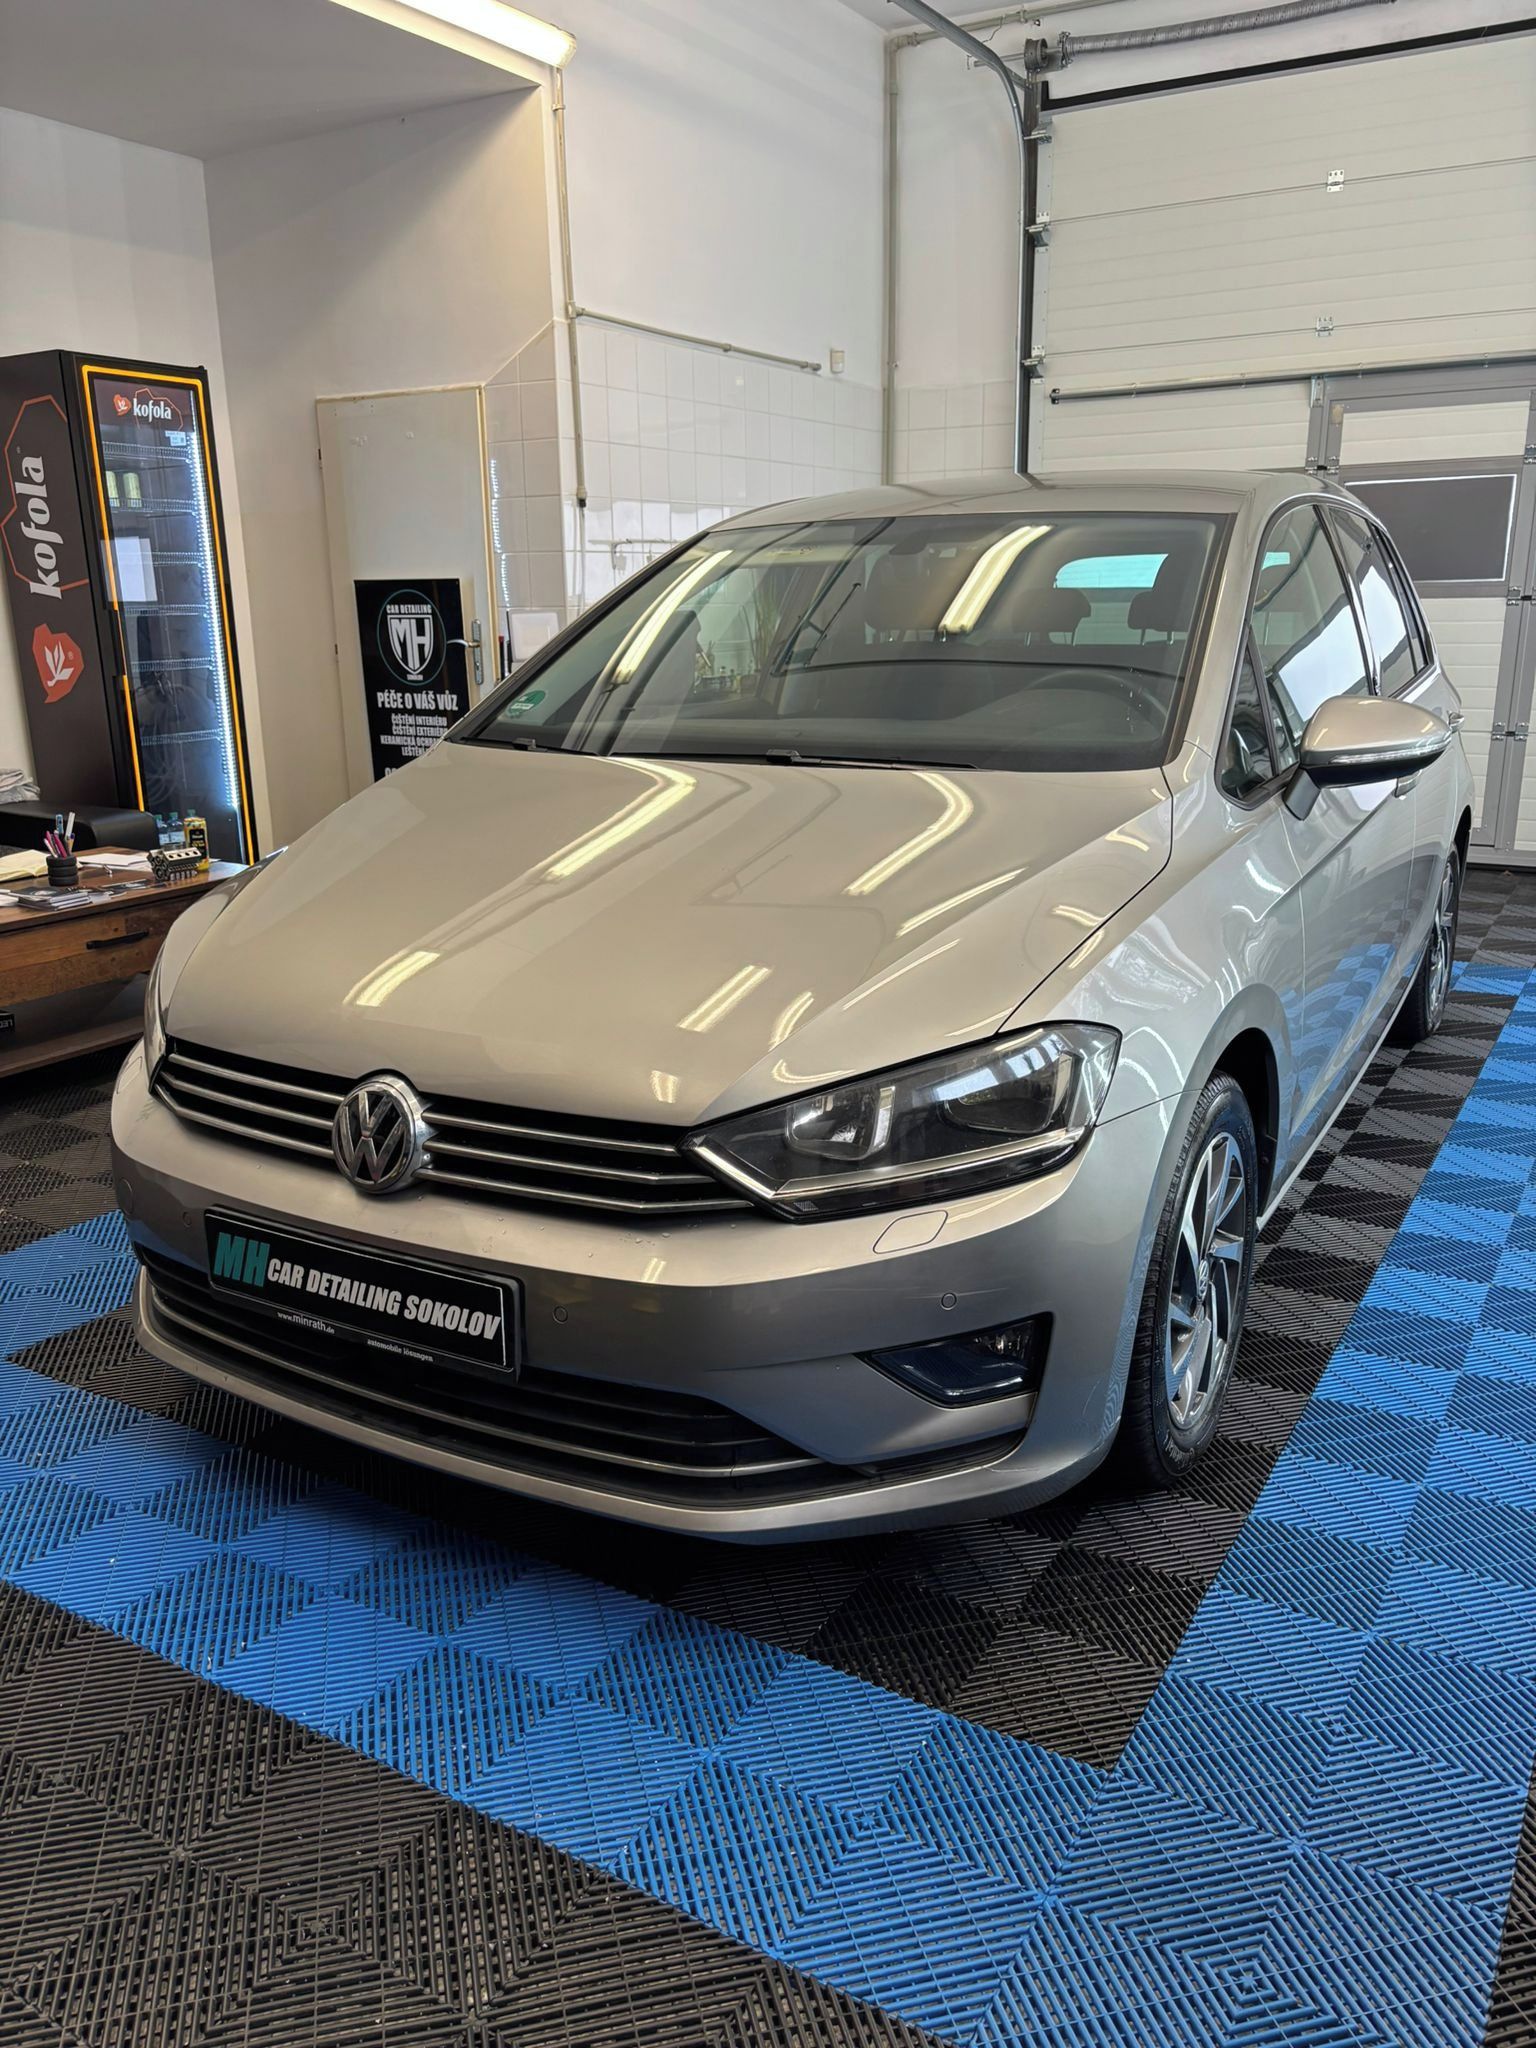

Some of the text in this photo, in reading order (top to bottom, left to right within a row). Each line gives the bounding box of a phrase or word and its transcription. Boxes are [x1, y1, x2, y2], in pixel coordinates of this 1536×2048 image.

[133, 398, 172, 422] kofola
[15, 456, 64, 600] kofola
[386, 604, 432, 614] CAR DETAILING
[390, 618, 430, 671] MH
[377, 689, 458, 710] PÉČE O VÁŠ VŮZ
[213, 1231, 502, 1340] MH CAR DETAILING SOKOLOV
[277, 1311, 335, 1335] www.minrath.de
[367, 1338, 402, 1355] automobile
